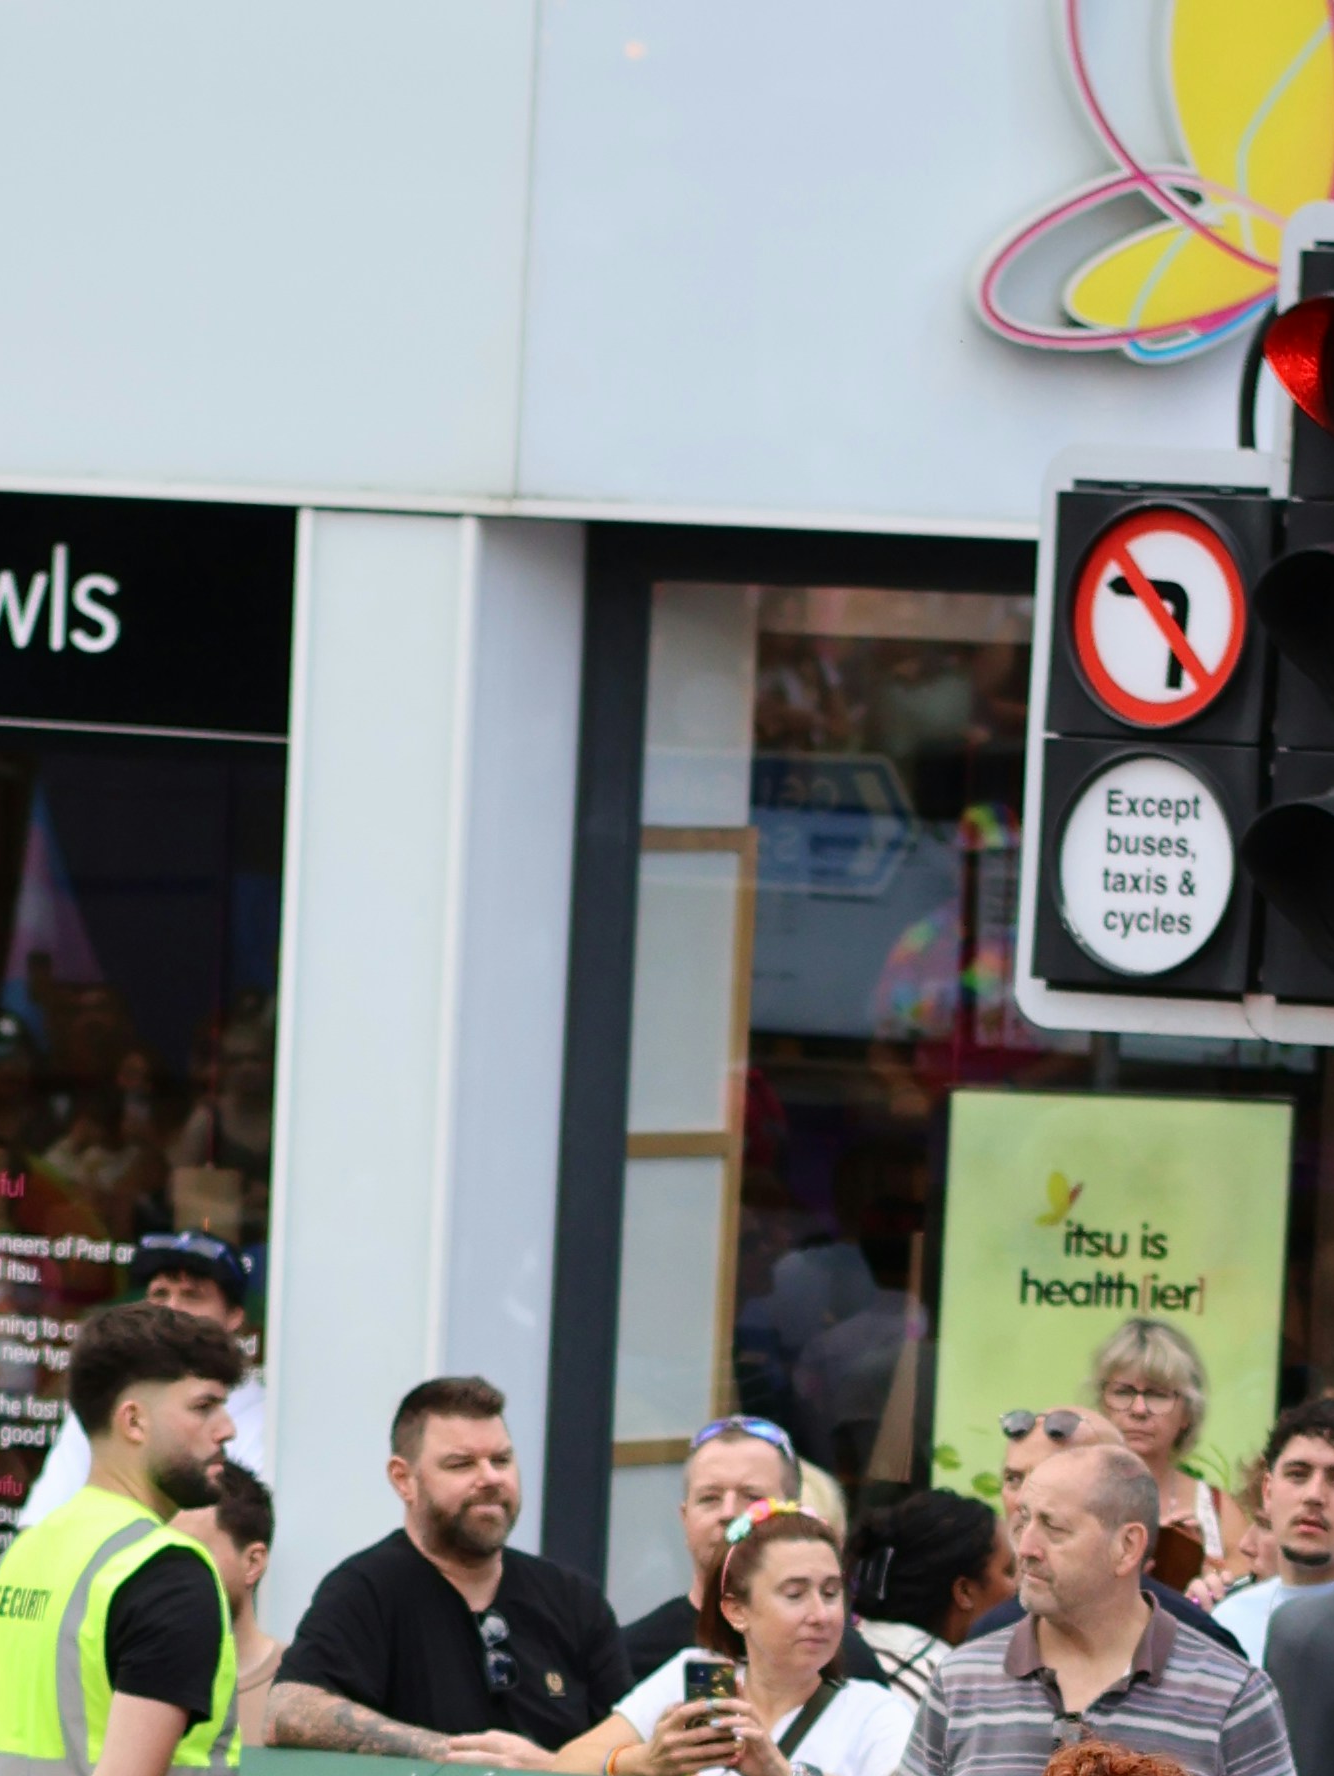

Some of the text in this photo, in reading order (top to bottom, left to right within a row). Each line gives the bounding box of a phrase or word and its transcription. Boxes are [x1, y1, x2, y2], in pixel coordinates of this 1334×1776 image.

[1105, 786, 1203, 827] Except
[1105, 827, 1197, 861] buses,
[1101, 866, 1197, 898] taxis &
[1102, 906, 1193, 939] cycles
[54, 1235, 74, 1256] of
[75, 1238, 110, 1261] Pret
[1063, 1220, 1169, 1261] itsu is
[42, 1320, 60, 1341] to
[2, 1343, 39, 1363] new
[43, 1345, 70, 1372] typ
